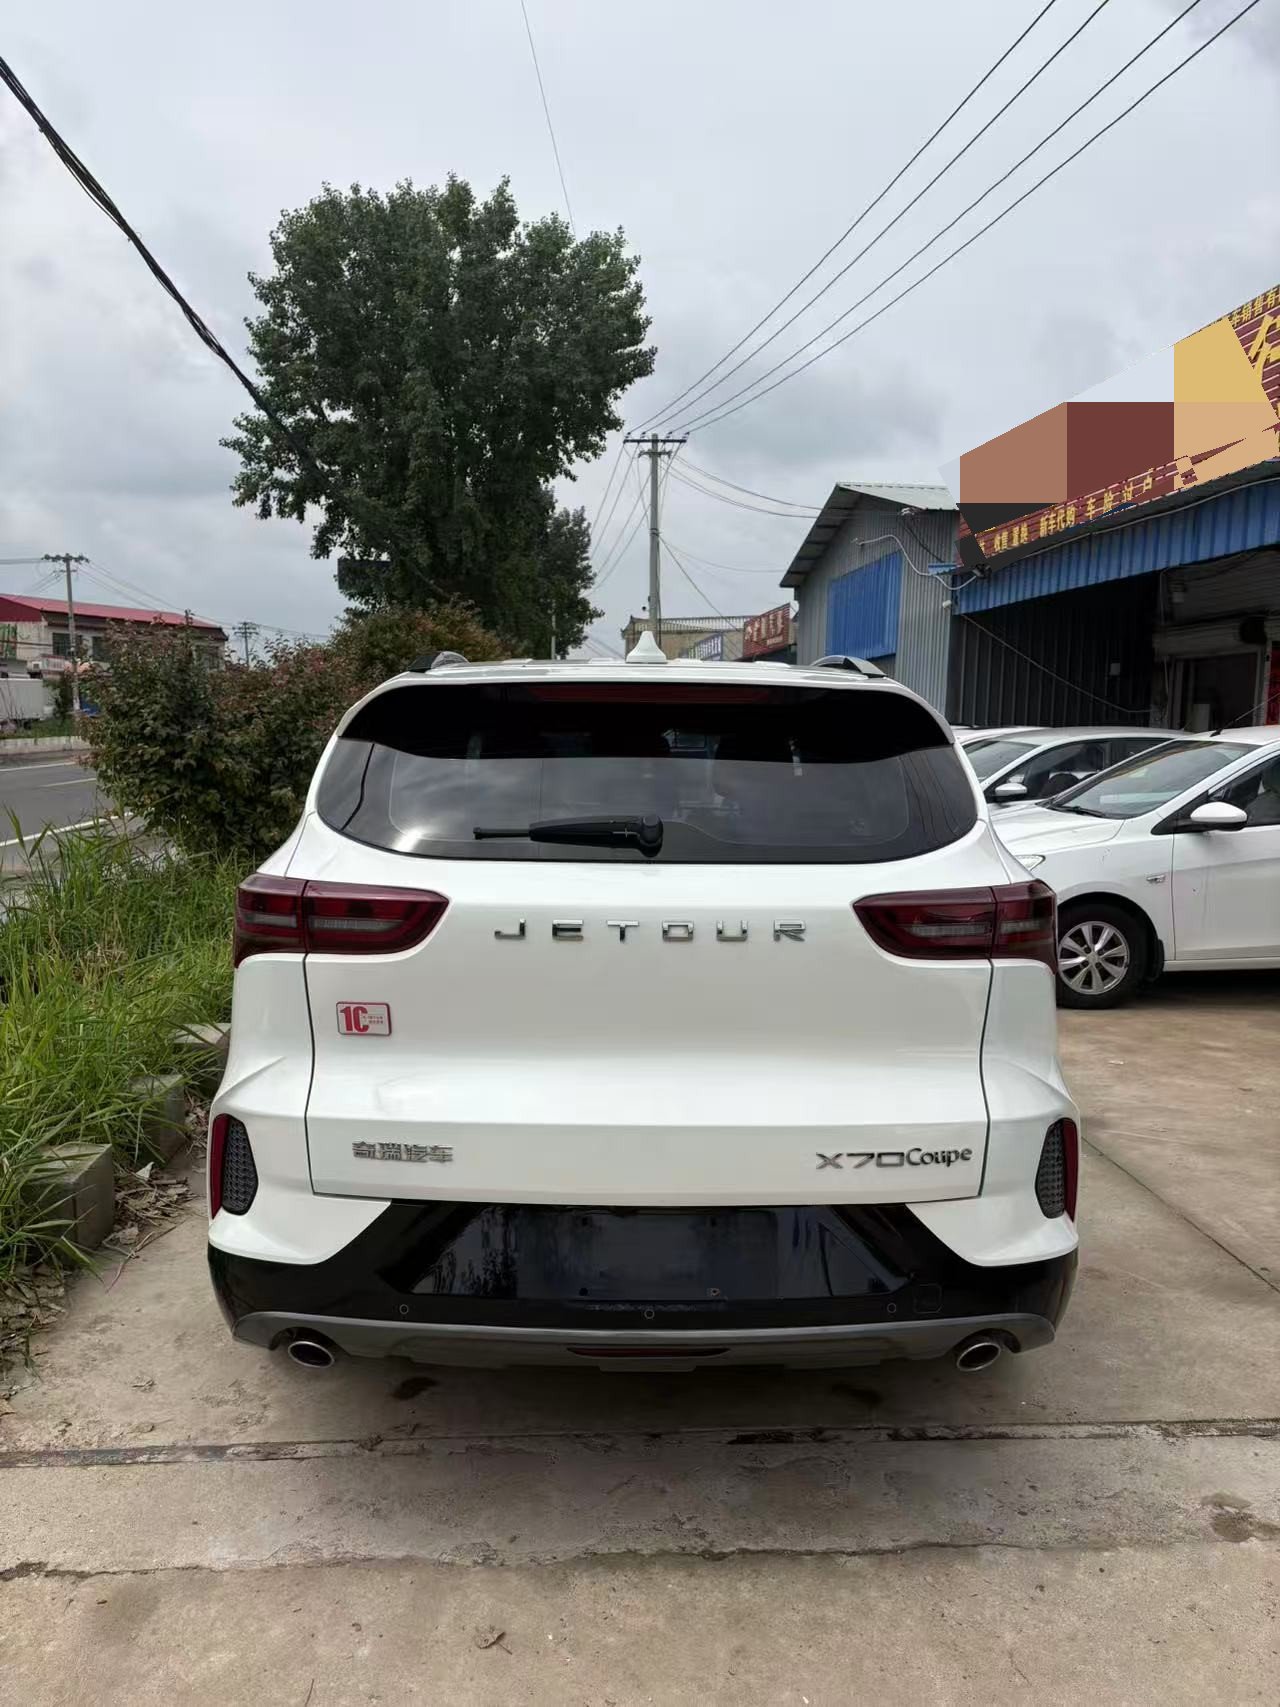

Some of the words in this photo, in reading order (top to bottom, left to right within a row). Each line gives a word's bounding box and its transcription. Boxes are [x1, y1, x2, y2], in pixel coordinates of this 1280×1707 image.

[494, 918, 805, 942] JETOUR
[352, 1141, 453, 1163] 奇瑞汽车
